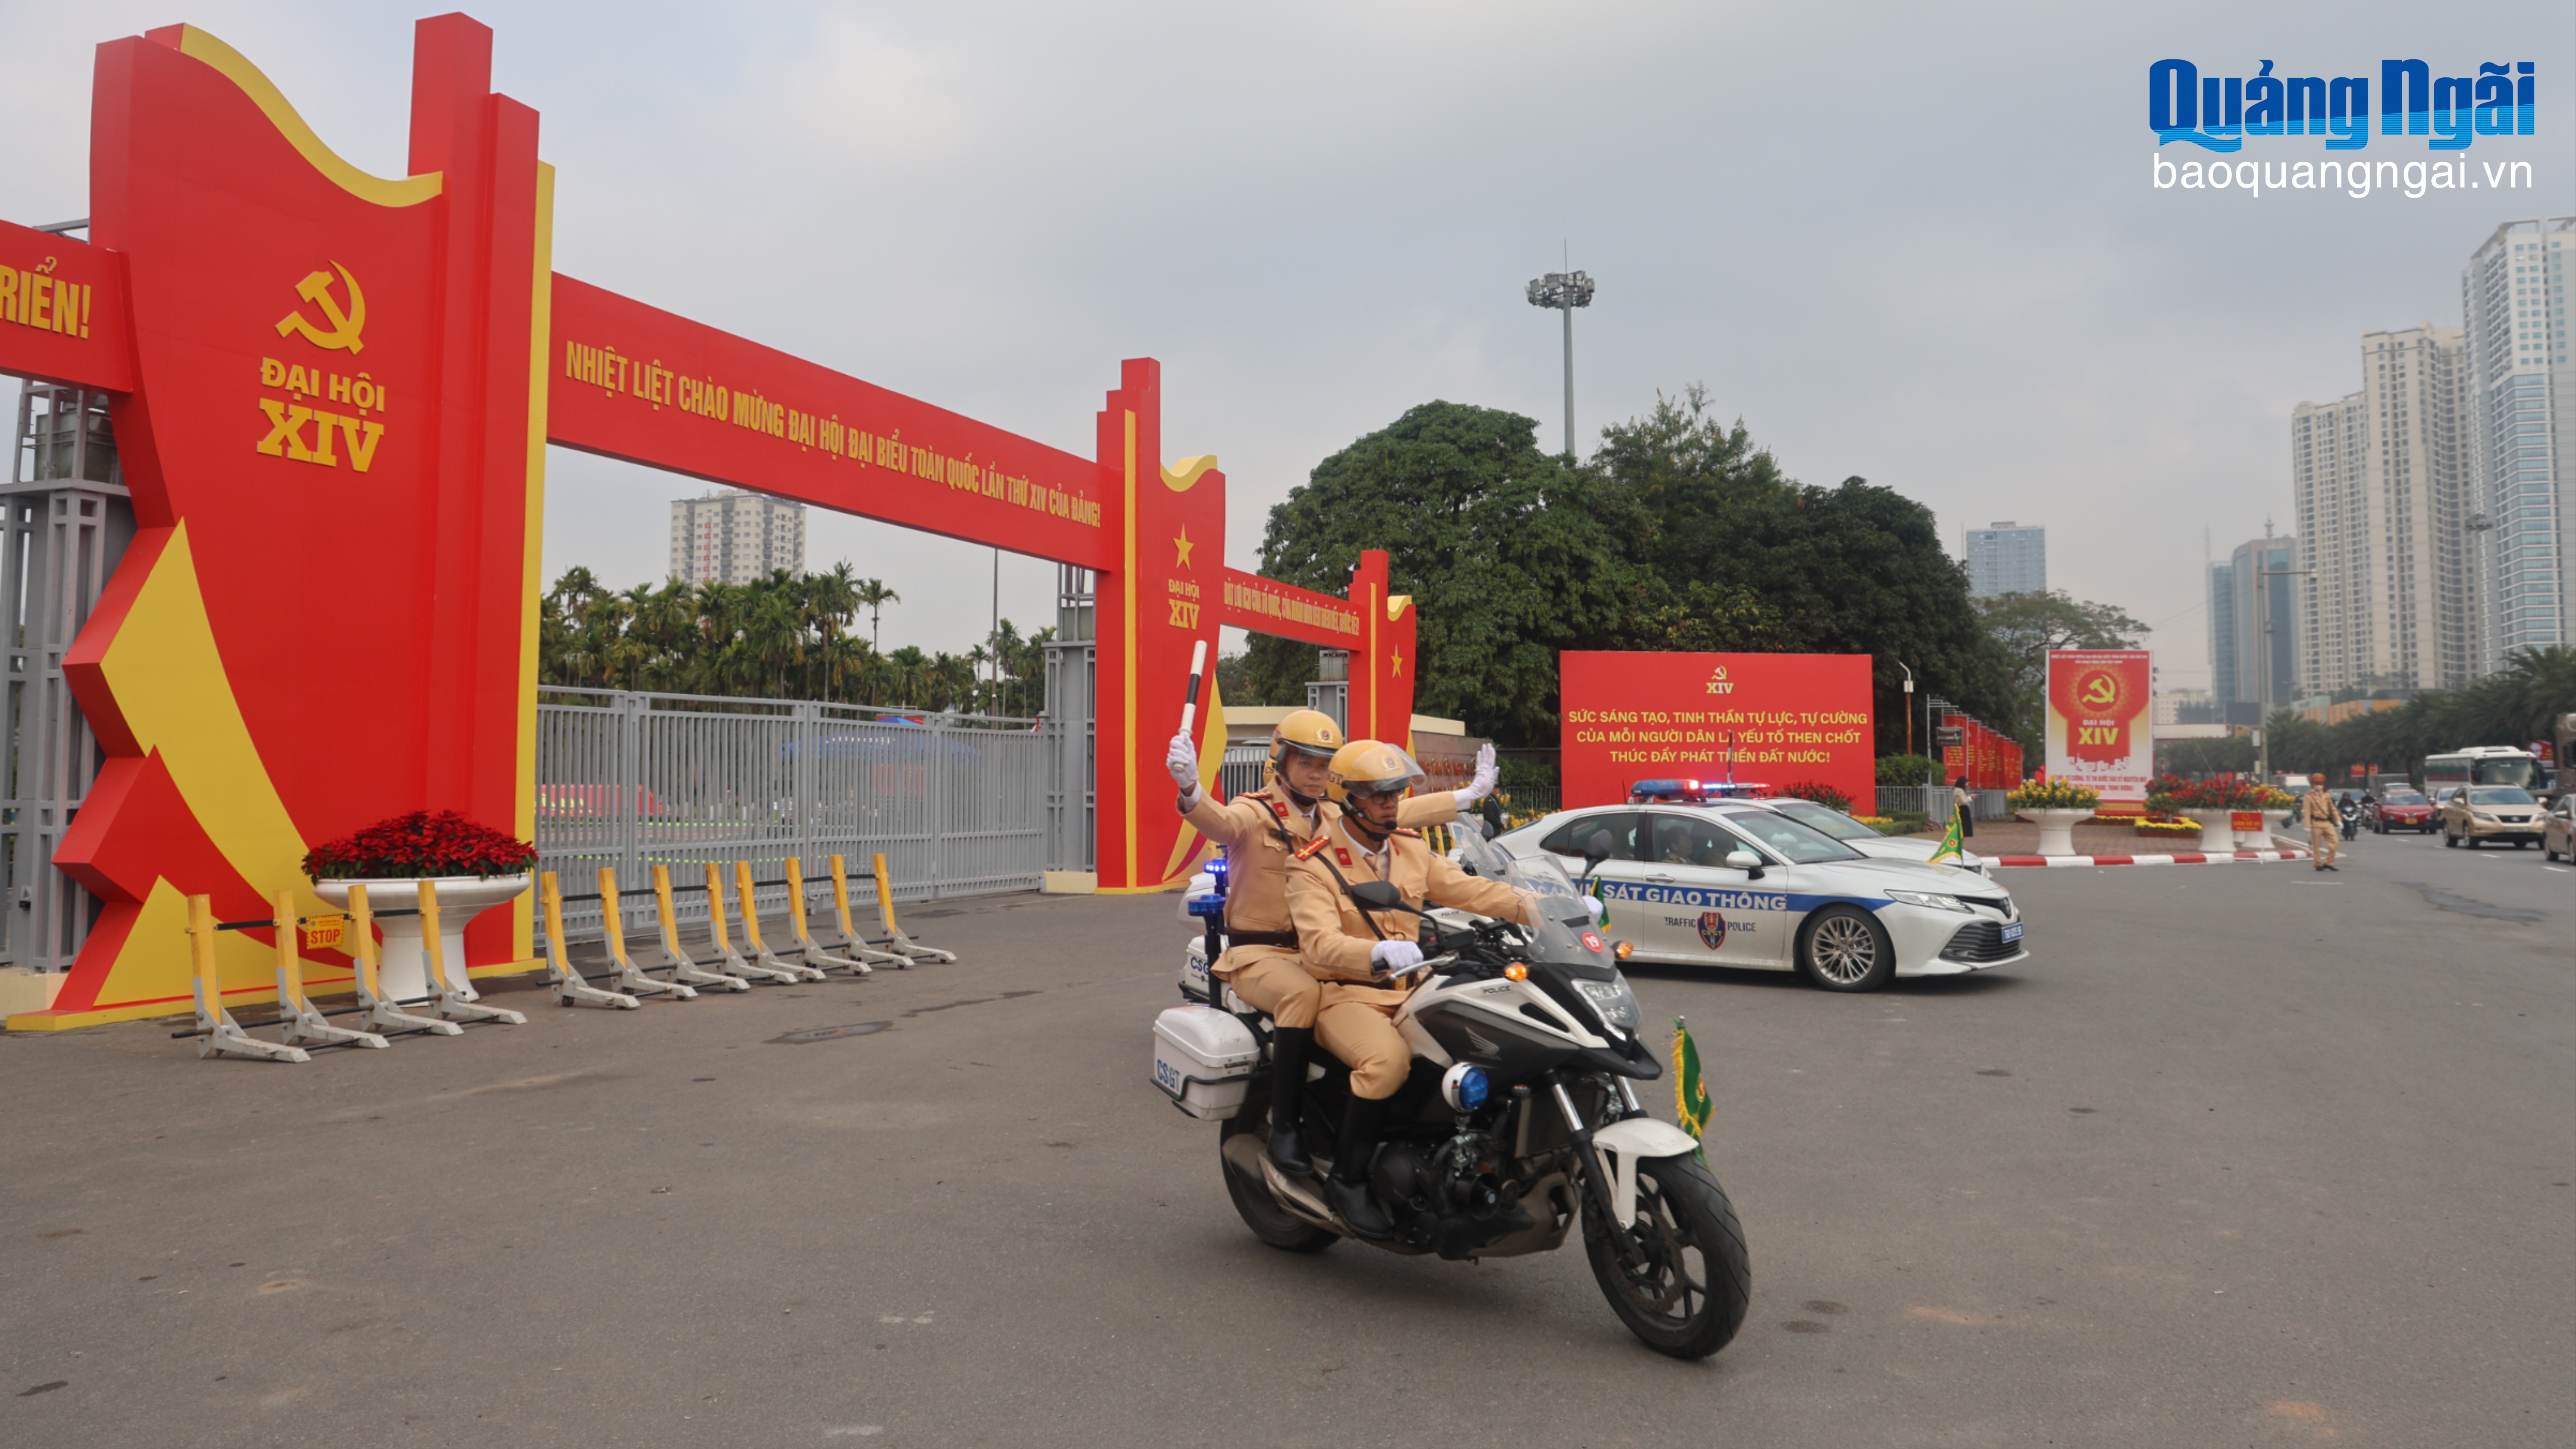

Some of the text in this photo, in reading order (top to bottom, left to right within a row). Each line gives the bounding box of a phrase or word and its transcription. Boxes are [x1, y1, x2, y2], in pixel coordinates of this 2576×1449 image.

[260, 357, 385, 416] ĐẠI HỘI
[257, 397, 384, 473] XIV
[565, 340, 1101, 528] NHIỆT LIỆT CHÀO MỪNG ĐẠI HỘI ĐẠI BIỂU TOÀN QUỐC LẦN THỨ XIV CỦA ĐẢNG!
[1168, 578, 1200, 601] ĐẠI HỘI
[1169, 598, 1200, 630] XIV
[1706, 682, 1734, 694] XIV
[1568, 708, 1868, 727] SỨC SÁNG TẠO, TINH THẦN TỰ LỰC, TỰ CƯỜNG
[1577, 727, 1606, 742] CỦA
[1609, 727, 1635, 743] MỖI
[1639, 729, 1683, 743] NGƯỜI
[1686, 729, 1715, 743] DÂN
[1738, 728, 1764, 743] YẾU
[1767, 728, 1784, 743] TỐ
[1787, 732, 1822, 743] THEN
[1825, 729, 1861, 743] CHỐT
[2078, 727, 2119, 745] XIV
[1610, 748, 1647, 762] THÚC
[1650, 747, 1677, 762] ĐẨY
[1680, 748, 1715, 762] PHÁT
[1759, 747, 1785, 762] ĐẤT
[1787, 748, 1830, 763] NƯỚC!
[1604, 884, 1643, 901] SÁT
[1646, 888, 1702, 905] GIAO
[1707, 891, 1787, 911] THÔNG
[1664, 917, 1756, 932] TRAFFIC POLICE
[310, 929, 340, 944] STOP
[1586, 936, 1600, 948] 19
[1482, 985, 1511, 995] POLICE
[1157, 1059, 1180, 1092] CSGT
